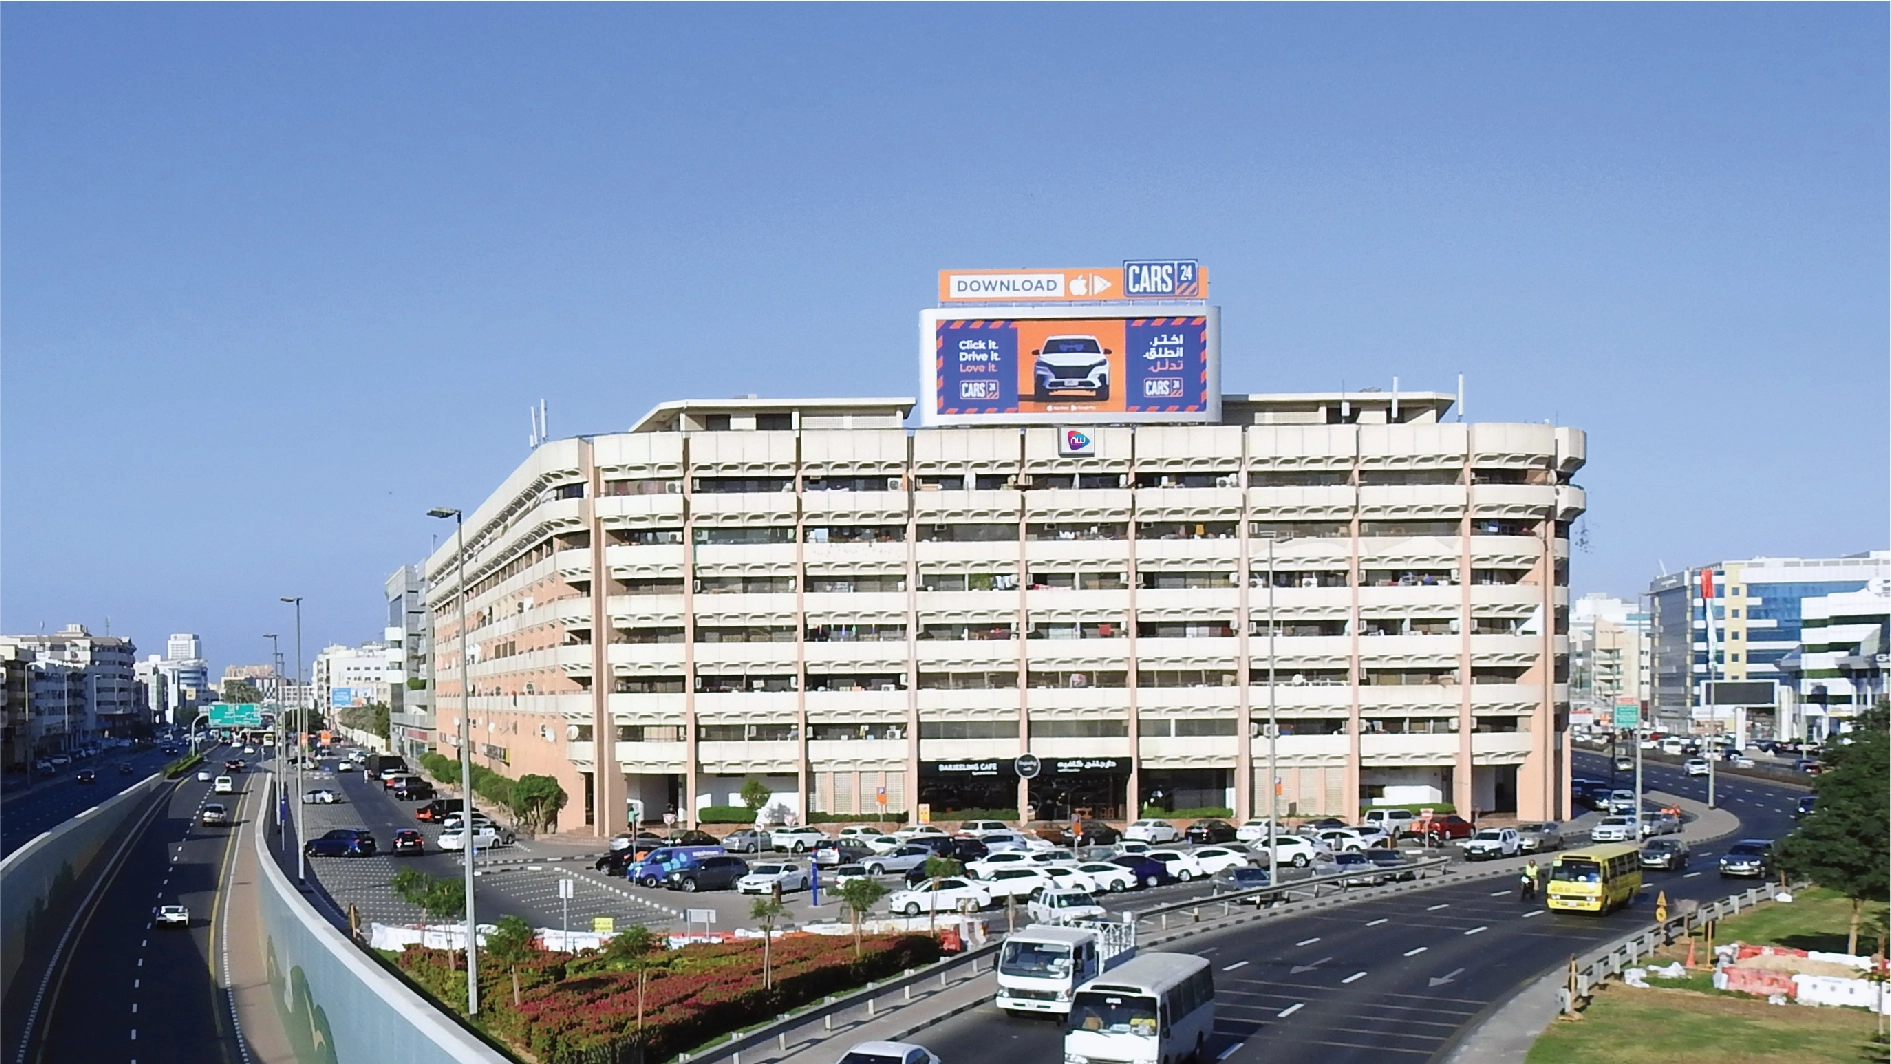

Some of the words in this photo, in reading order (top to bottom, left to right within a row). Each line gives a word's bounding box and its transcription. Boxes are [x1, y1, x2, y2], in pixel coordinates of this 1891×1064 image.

[1128, 264, 1173, 293] CARS
[1180, 264, 1193, 281] 24
[957, 279, 1057, 292] DOWNLOAD
[959, 339, 986, 350] Click
[959, 350, 988, 362] Drive
[959, 363, 985, 372] Love
[961, 382, 986, 398] CARS
[1145, 380, 1170, 396] CARS
